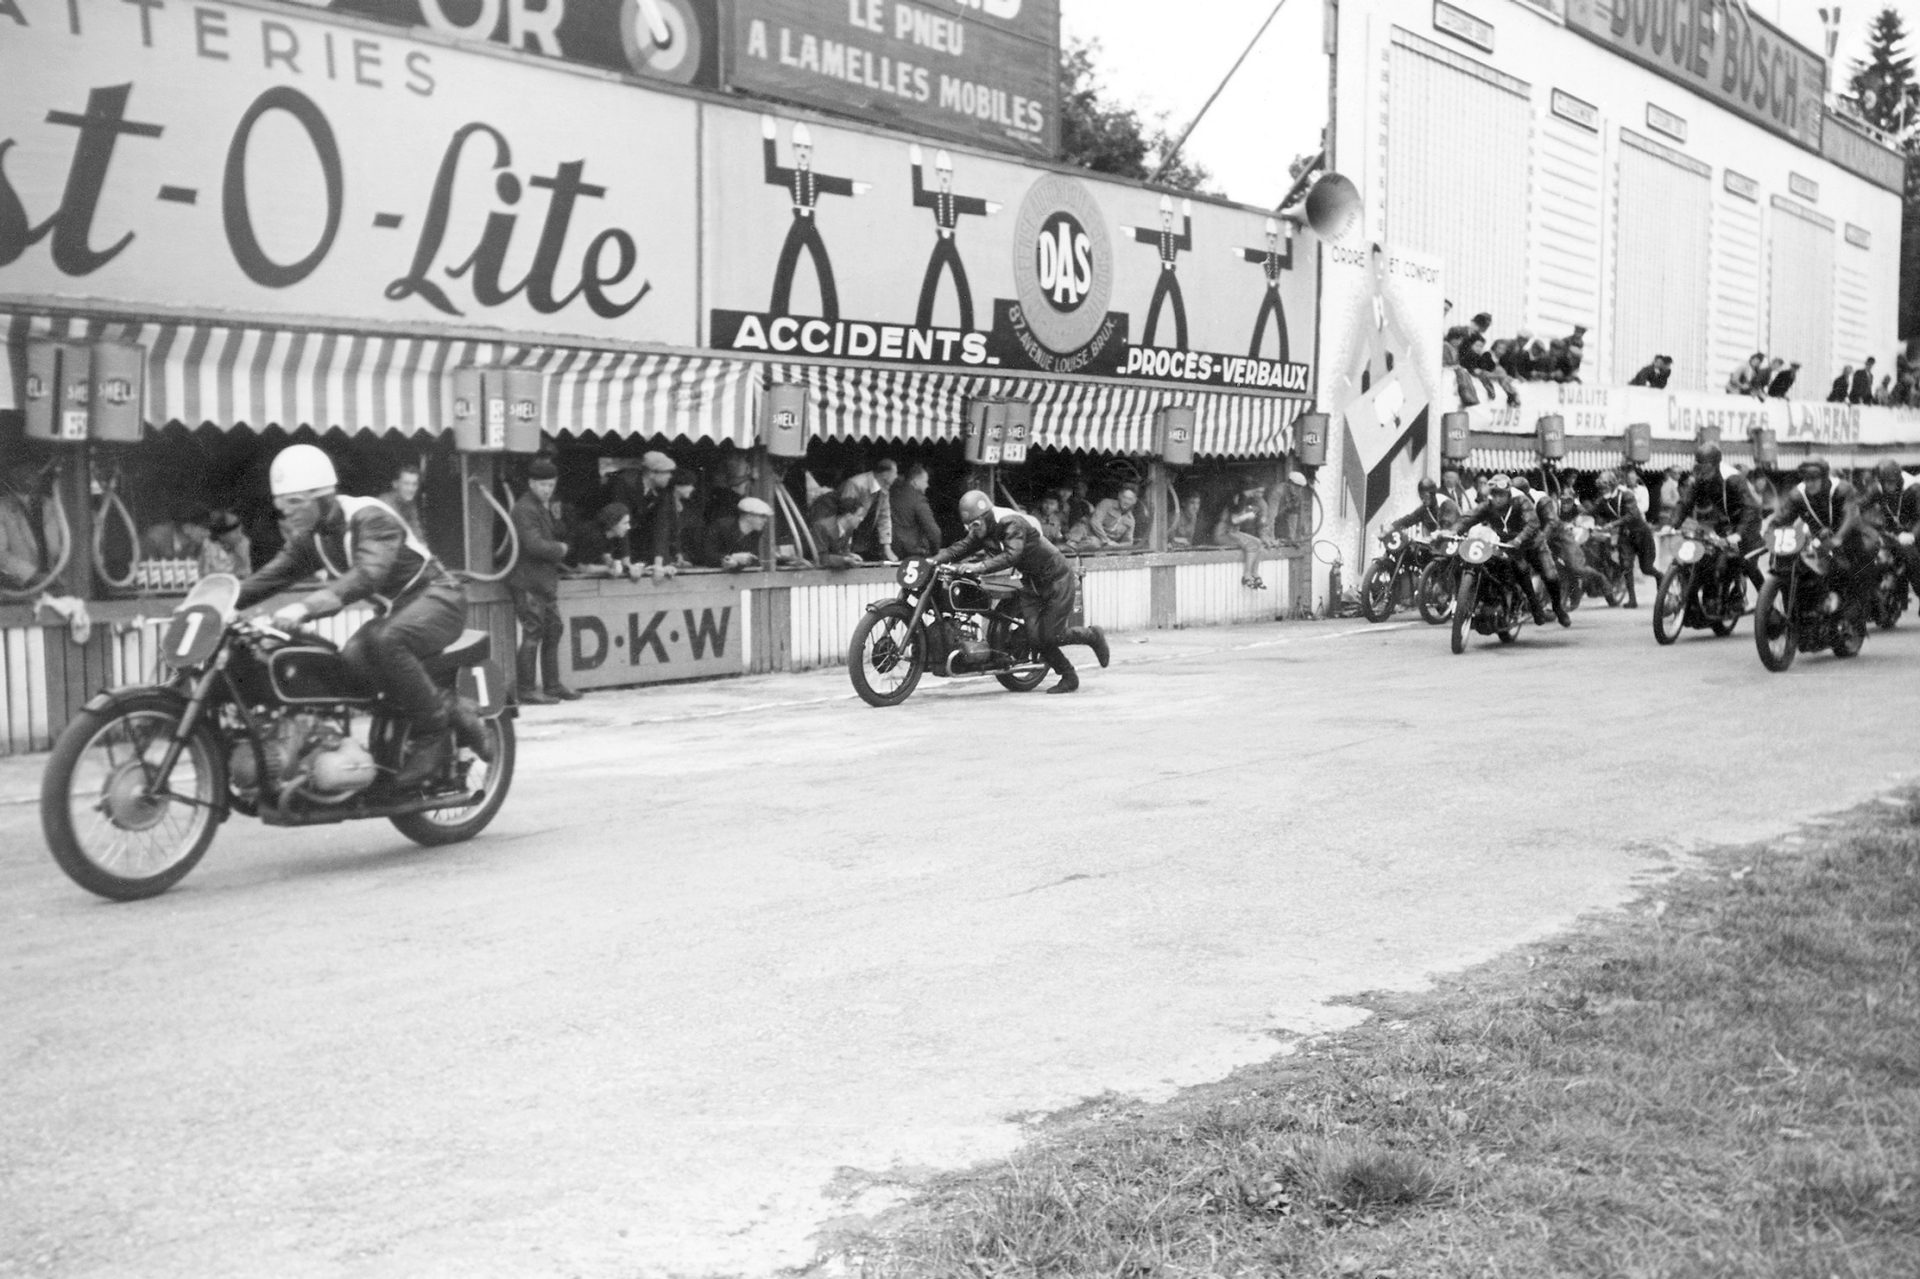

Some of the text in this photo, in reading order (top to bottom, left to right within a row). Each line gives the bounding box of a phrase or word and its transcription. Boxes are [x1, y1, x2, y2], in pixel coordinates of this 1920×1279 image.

[850, 0, 883, 33] LE
[895, 4, 964, 55] PNEU
[748, 19, 1044, 132] A LAMELLES MOBILES
[1721, 14, 1798, 129] BOSCH
[1039, 221, 1092, 304] DAS
[98, 381, 136, 401] SHELL
[509, 402, 539, 419] SHELL
[773, 410, 799, 427] SHELL
[1577, 411, 1607, 430] PRIX
[1387, 531, 1401, 550] 3
[1468, 540, 1485, 561] 6
[903, 560, 920, 585] 5
[176, 611, 205, 657] 1
[471, 666, 490, 708] 1
